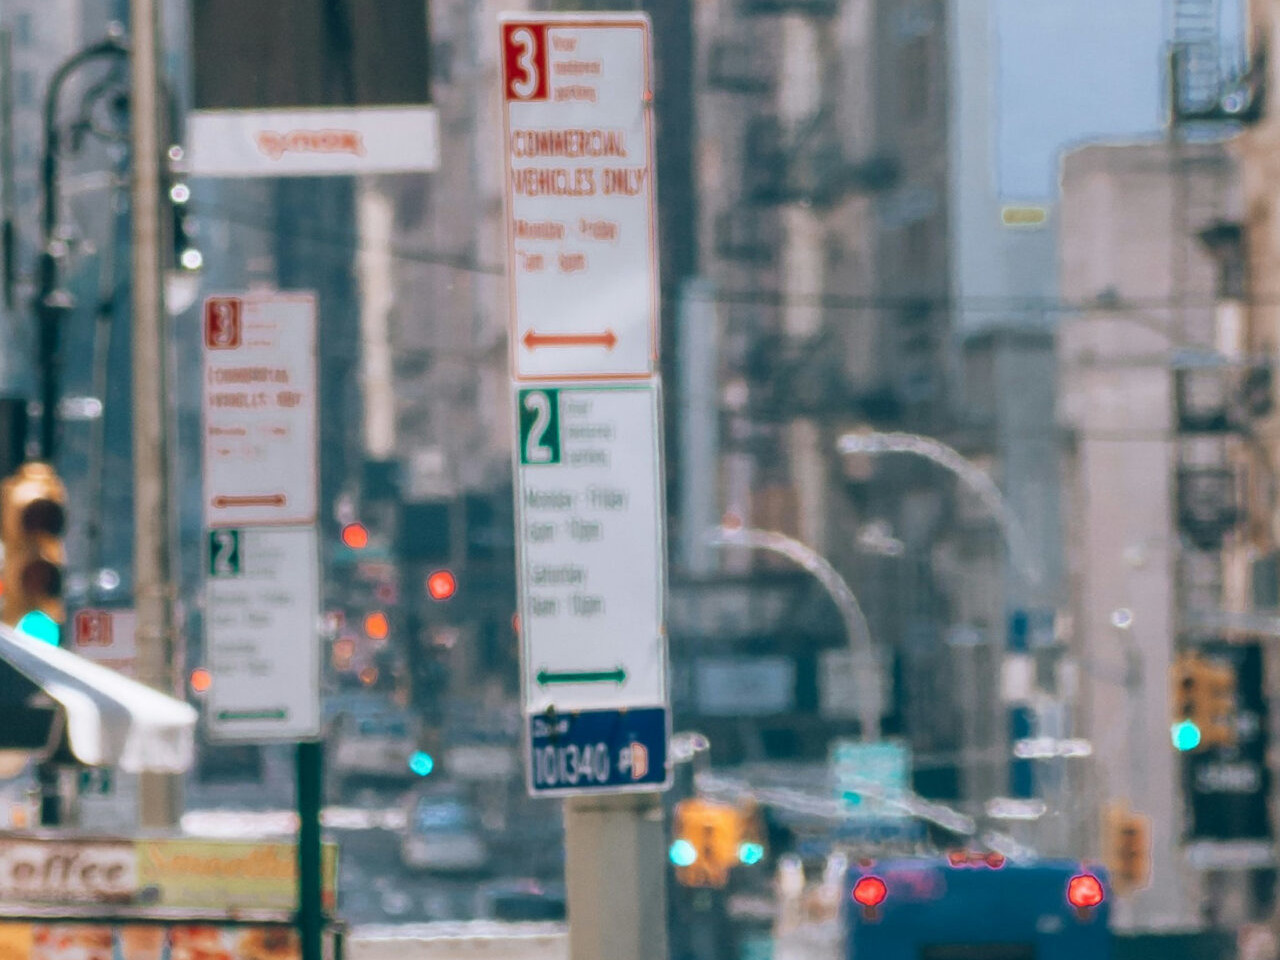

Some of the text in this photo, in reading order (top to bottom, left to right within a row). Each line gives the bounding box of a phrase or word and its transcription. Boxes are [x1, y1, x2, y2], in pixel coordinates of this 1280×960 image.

[513, 28, 539, 98] 3
[513, 129, 628, 158] COMMERCIAL
[512, 167, 646, 197] VEHICLES ONLY
[524, 390, 553, 462] 2
